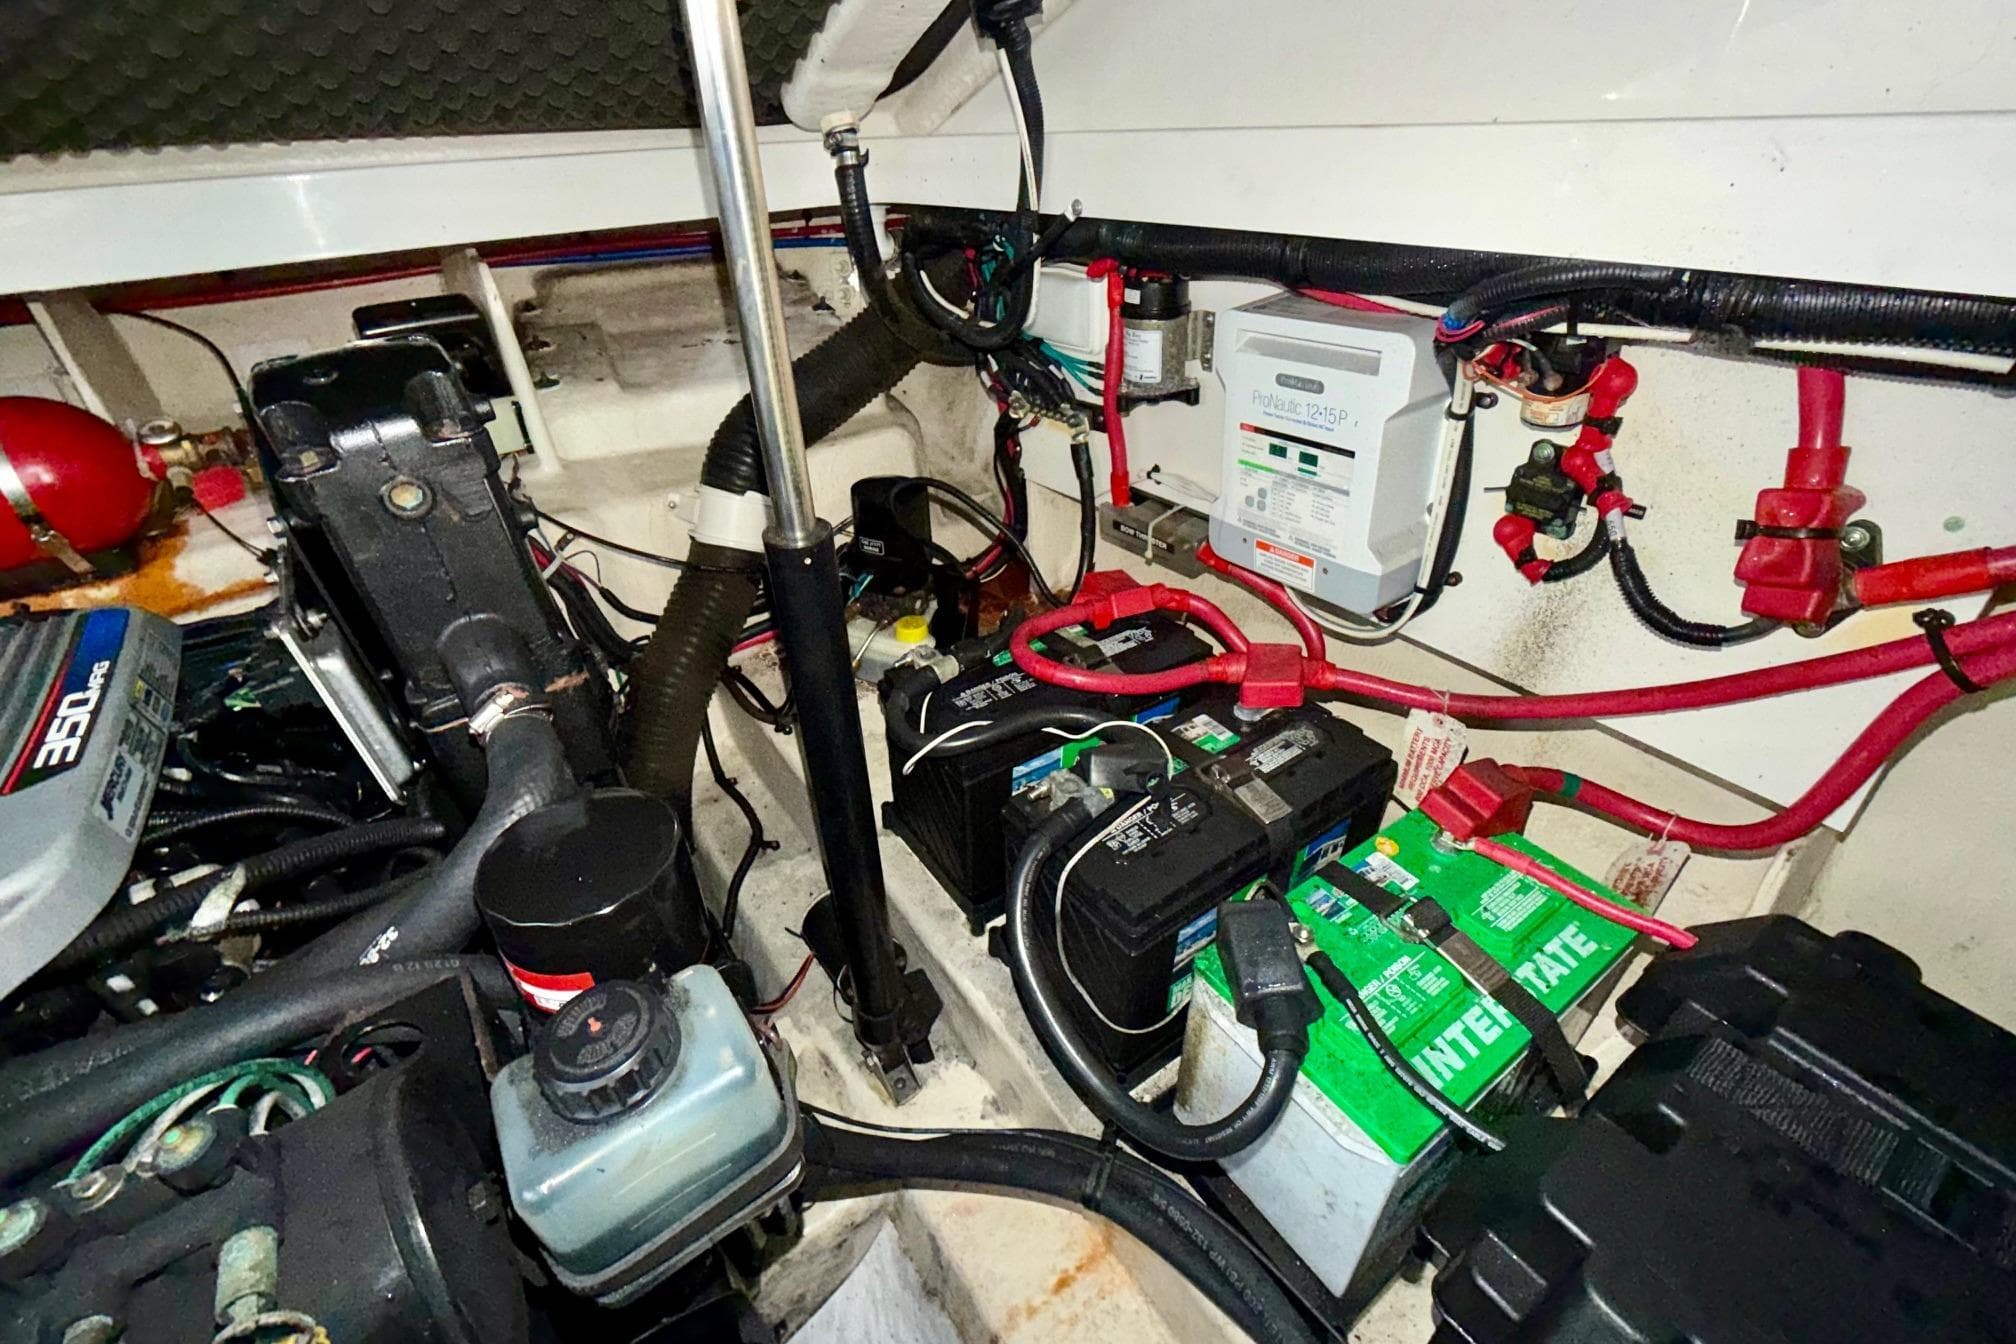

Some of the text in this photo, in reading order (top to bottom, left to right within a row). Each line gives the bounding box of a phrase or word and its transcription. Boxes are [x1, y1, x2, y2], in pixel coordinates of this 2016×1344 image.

[1252, 389, 1302, 416] ProNautic
[1119, 524, 1168, 550] BOW THRSTER
[1407, 727, 1423, 760] BATTERY
[1382, 952, 1412, 979] POISON
